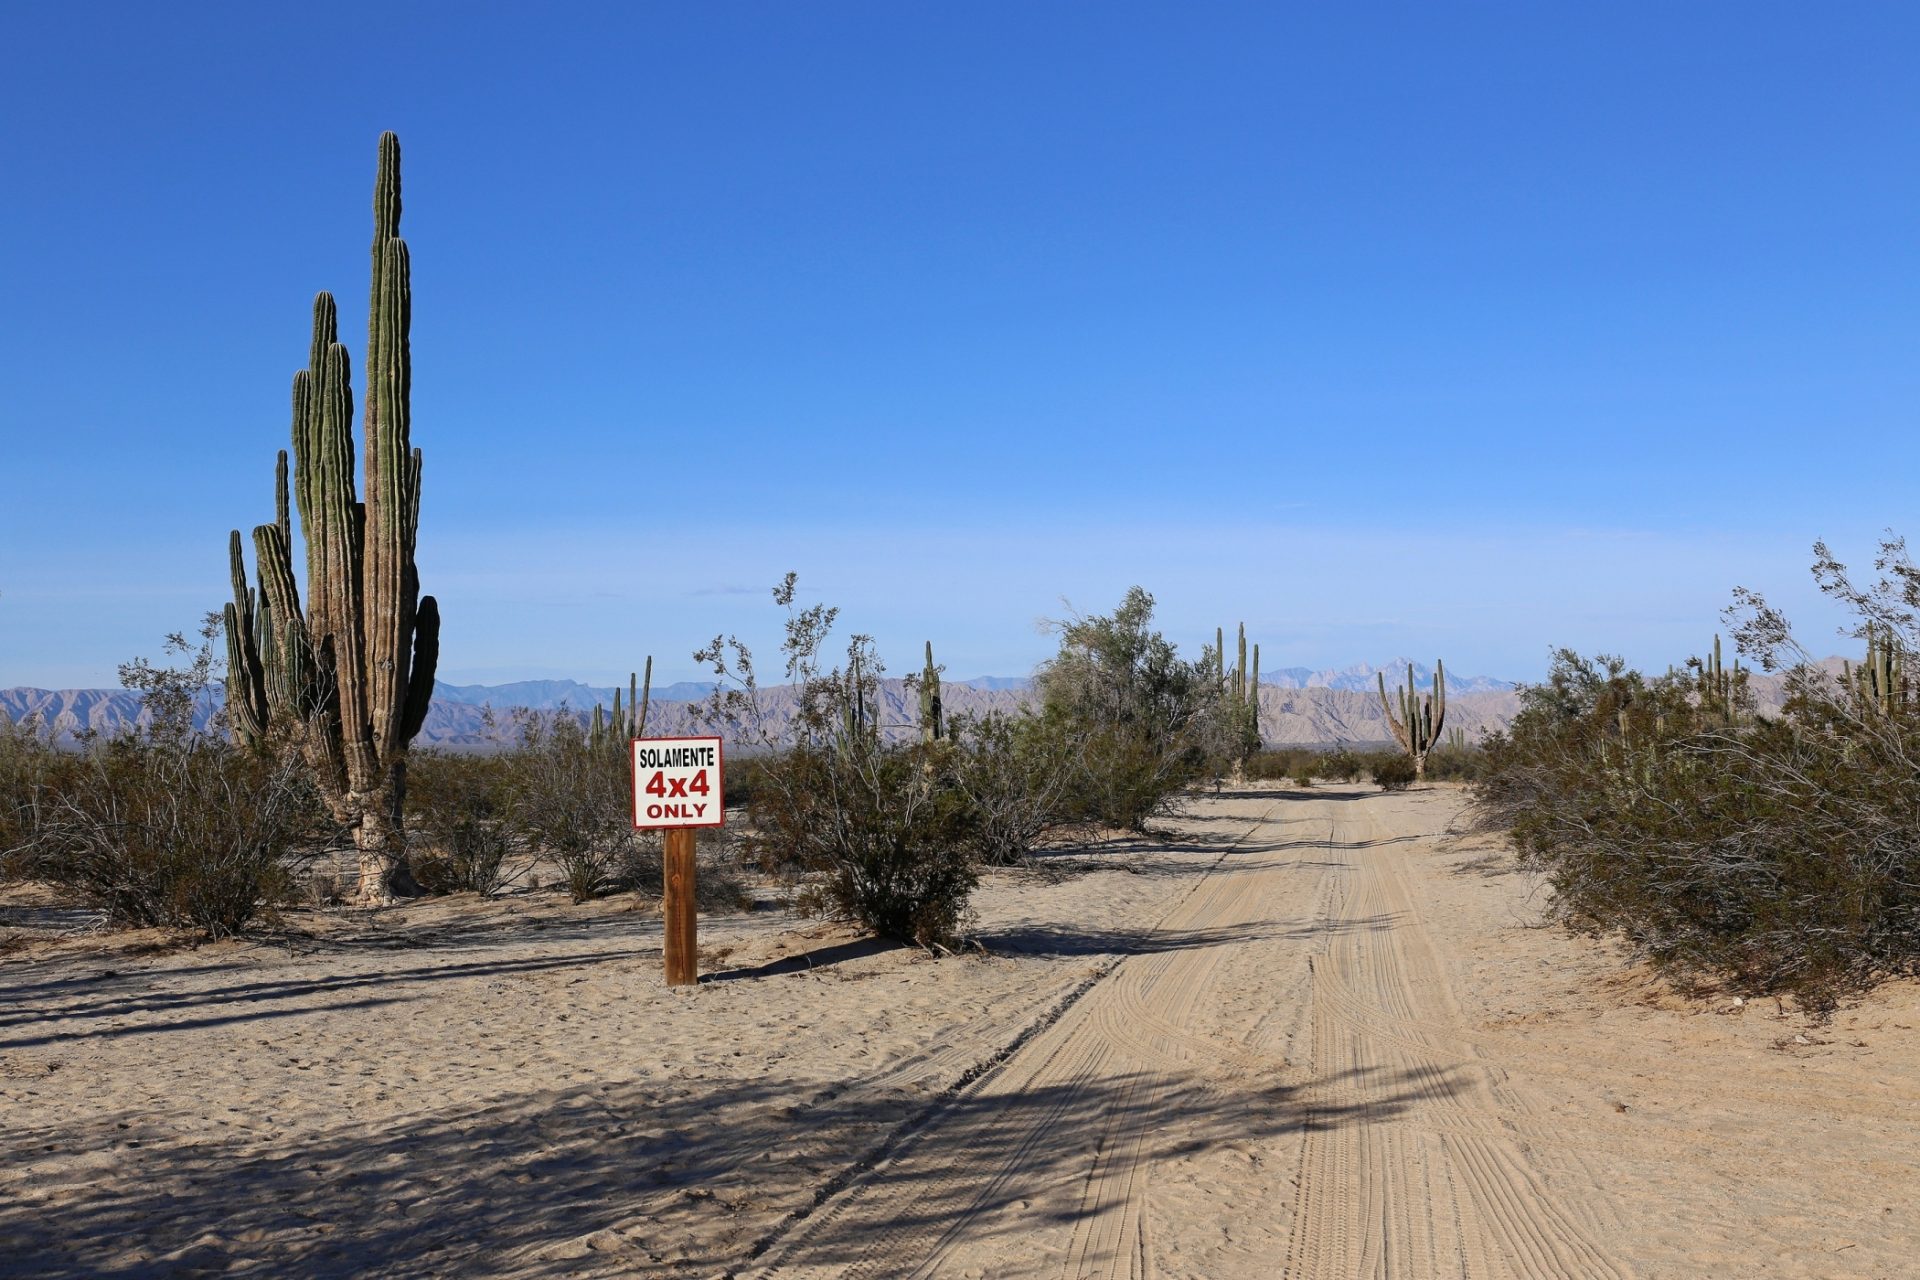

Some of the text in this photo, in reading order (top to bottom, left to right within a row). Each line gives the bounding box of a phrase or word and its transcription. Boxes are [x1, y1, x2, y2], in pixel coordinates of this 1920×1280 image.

[640, 747, 714, 768] SOLAMENTE
[645, 769, 710, 798] 4x4
[646, 803, 707, 818] ONLY
